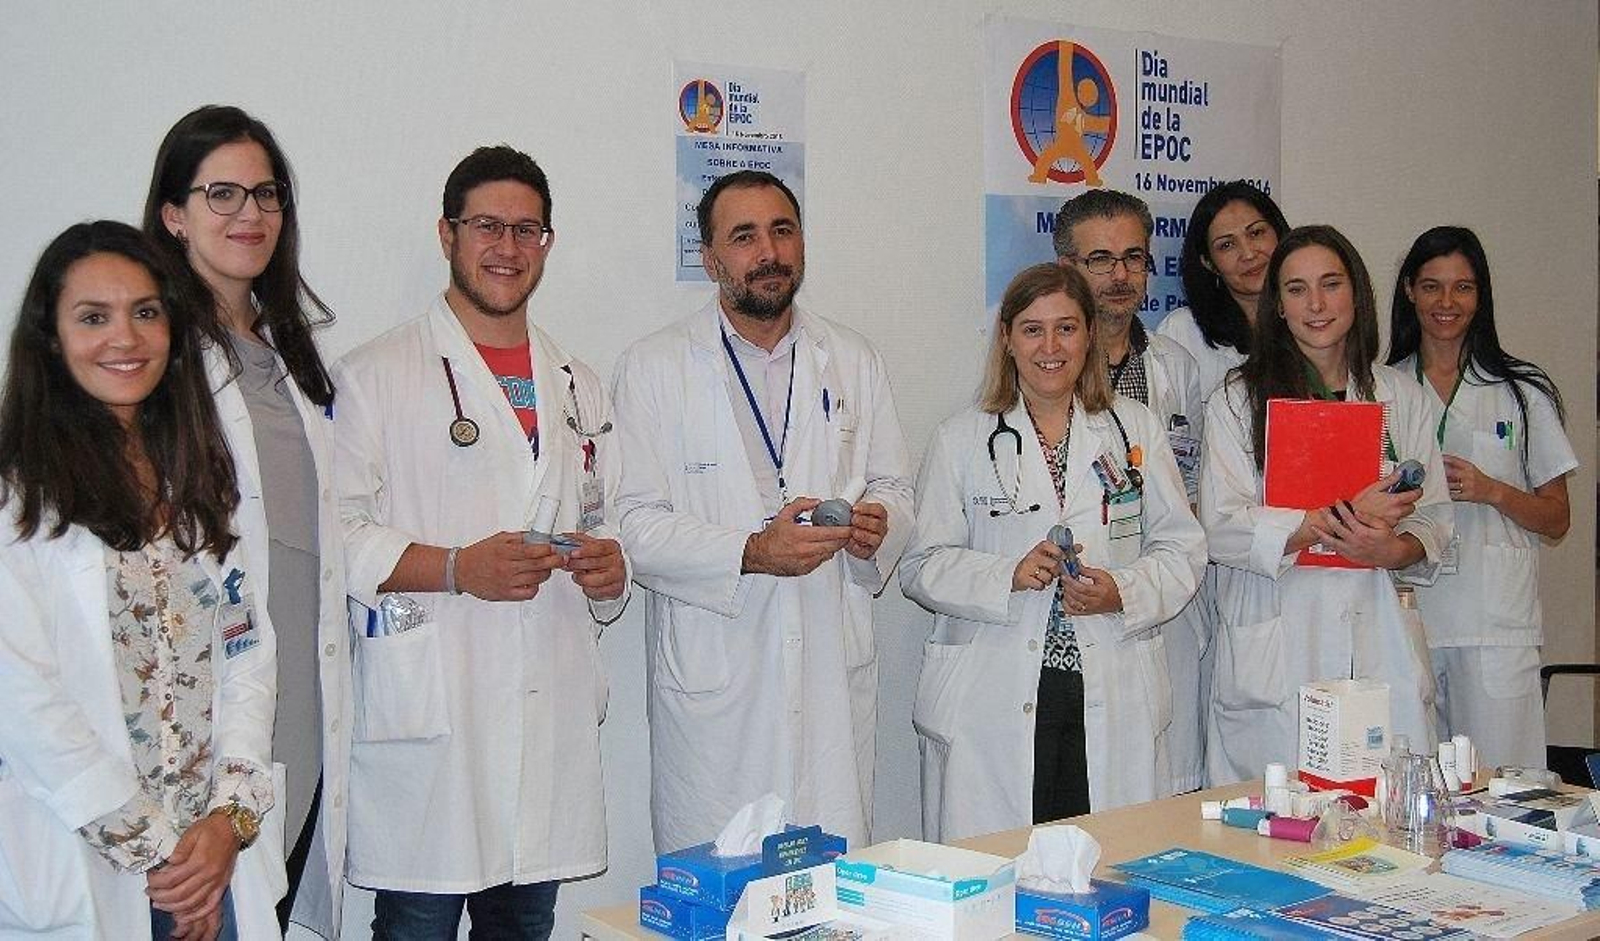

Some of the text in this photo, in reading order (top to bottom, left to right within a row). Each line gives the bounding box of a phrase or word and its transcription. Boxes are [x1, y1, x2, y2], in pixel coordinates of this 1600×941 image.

[1141, 50, 1168, 78] Día
[1141, 80, 1209, 106] mundial
[729, 113, 753, 124] EPOC
[1141, 105, 1180, 132] de la
[694, 141, 784, 154] MESA INFORMATIVA
[1141, 133, 1192, 162] EPOC
[707, 158, 738, 168] SOBRE
[747, 160, 771, 169] EPOC
[1135, 172, 1152, 191] 16
